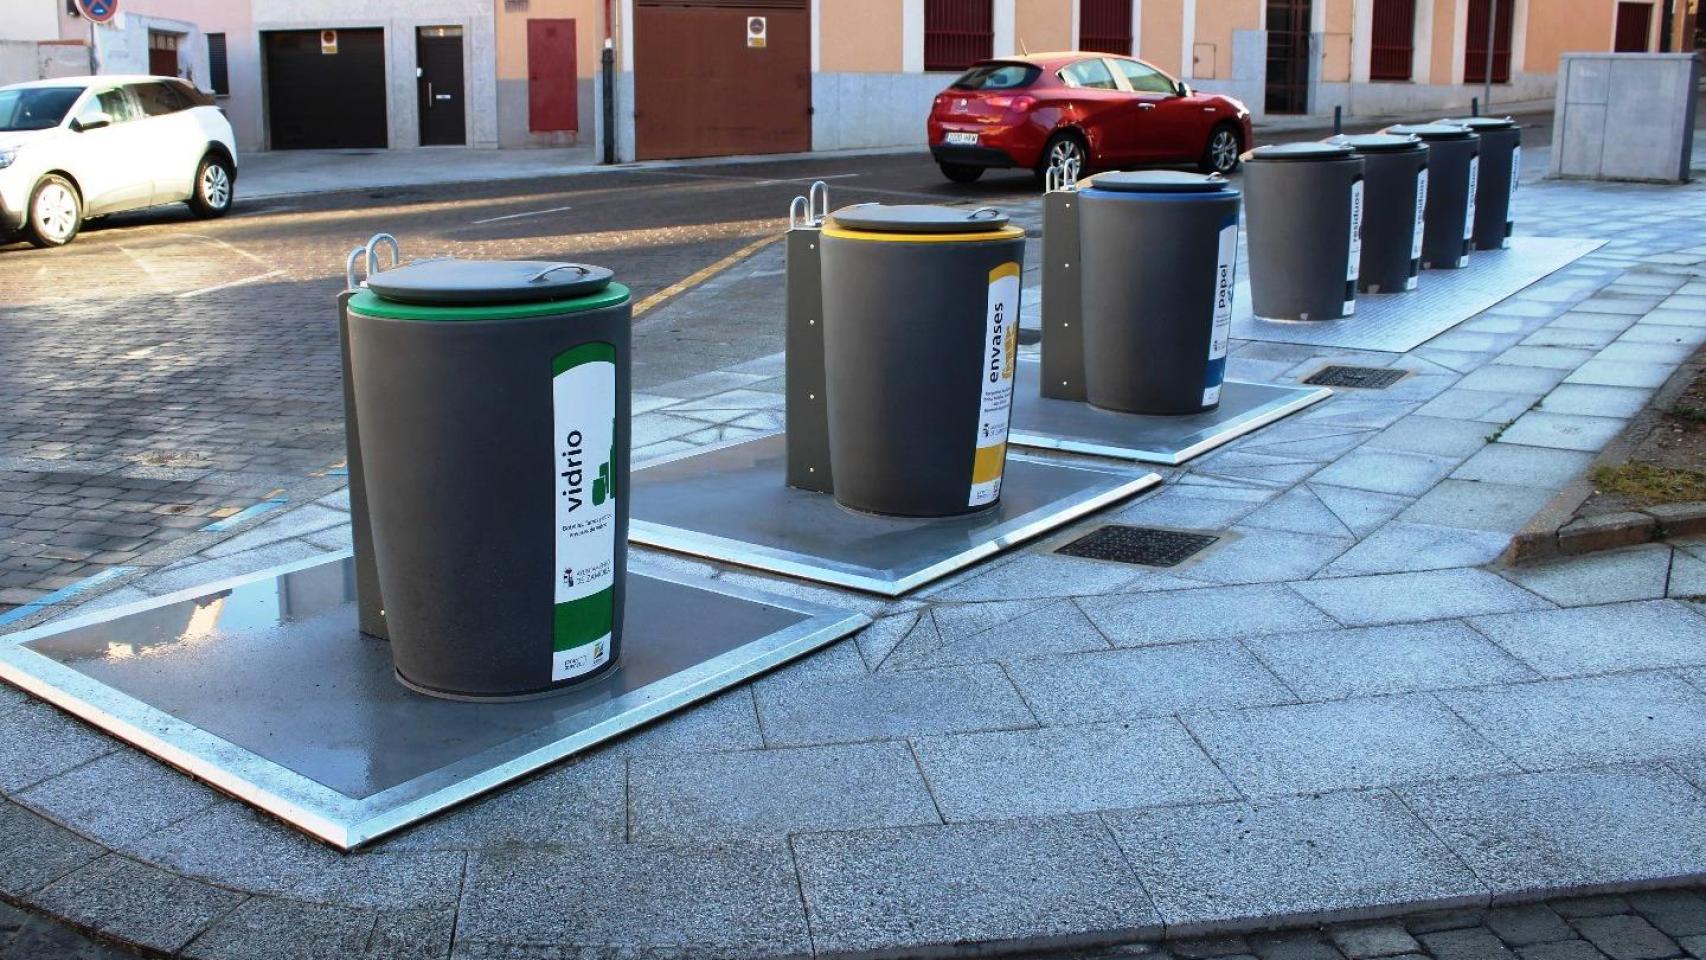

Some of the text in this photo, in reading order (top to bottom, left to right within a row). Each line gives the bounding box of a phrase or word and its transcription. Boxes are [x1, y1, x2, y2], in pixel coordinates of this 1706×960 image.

[1352, 191, 1360, 242] residuos
[1218, 263, 1228, 309] papel
[989, 302, 1003, 383] envases
[561, 429, 583, 513] vidrio
